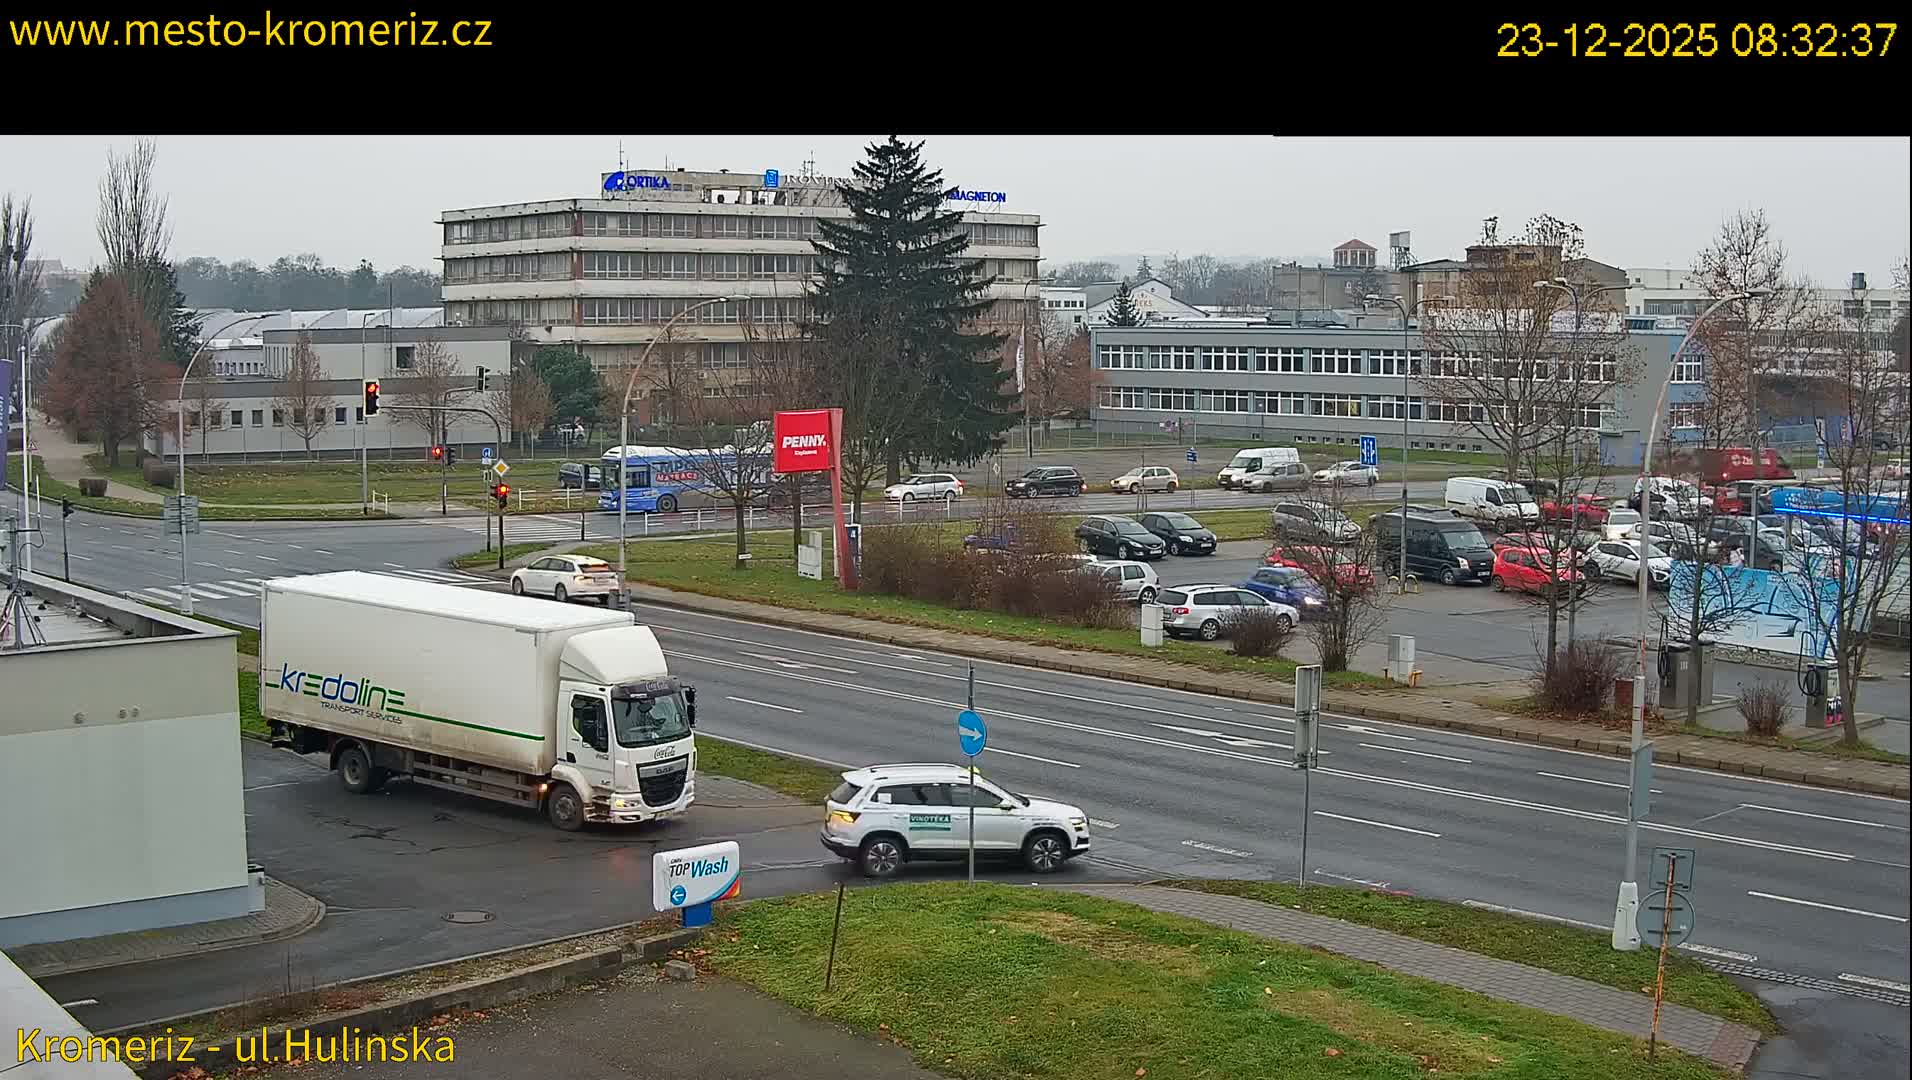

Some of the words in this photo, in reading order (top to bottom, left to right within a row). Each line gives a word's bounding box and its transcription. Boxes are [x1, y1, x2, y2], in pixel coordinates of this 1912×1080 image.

[626, 175, 671, 188] ORTIKA
[320, 701, 365, 716] TRANSPORT
[366, 710, 403, 724] SERVICES
